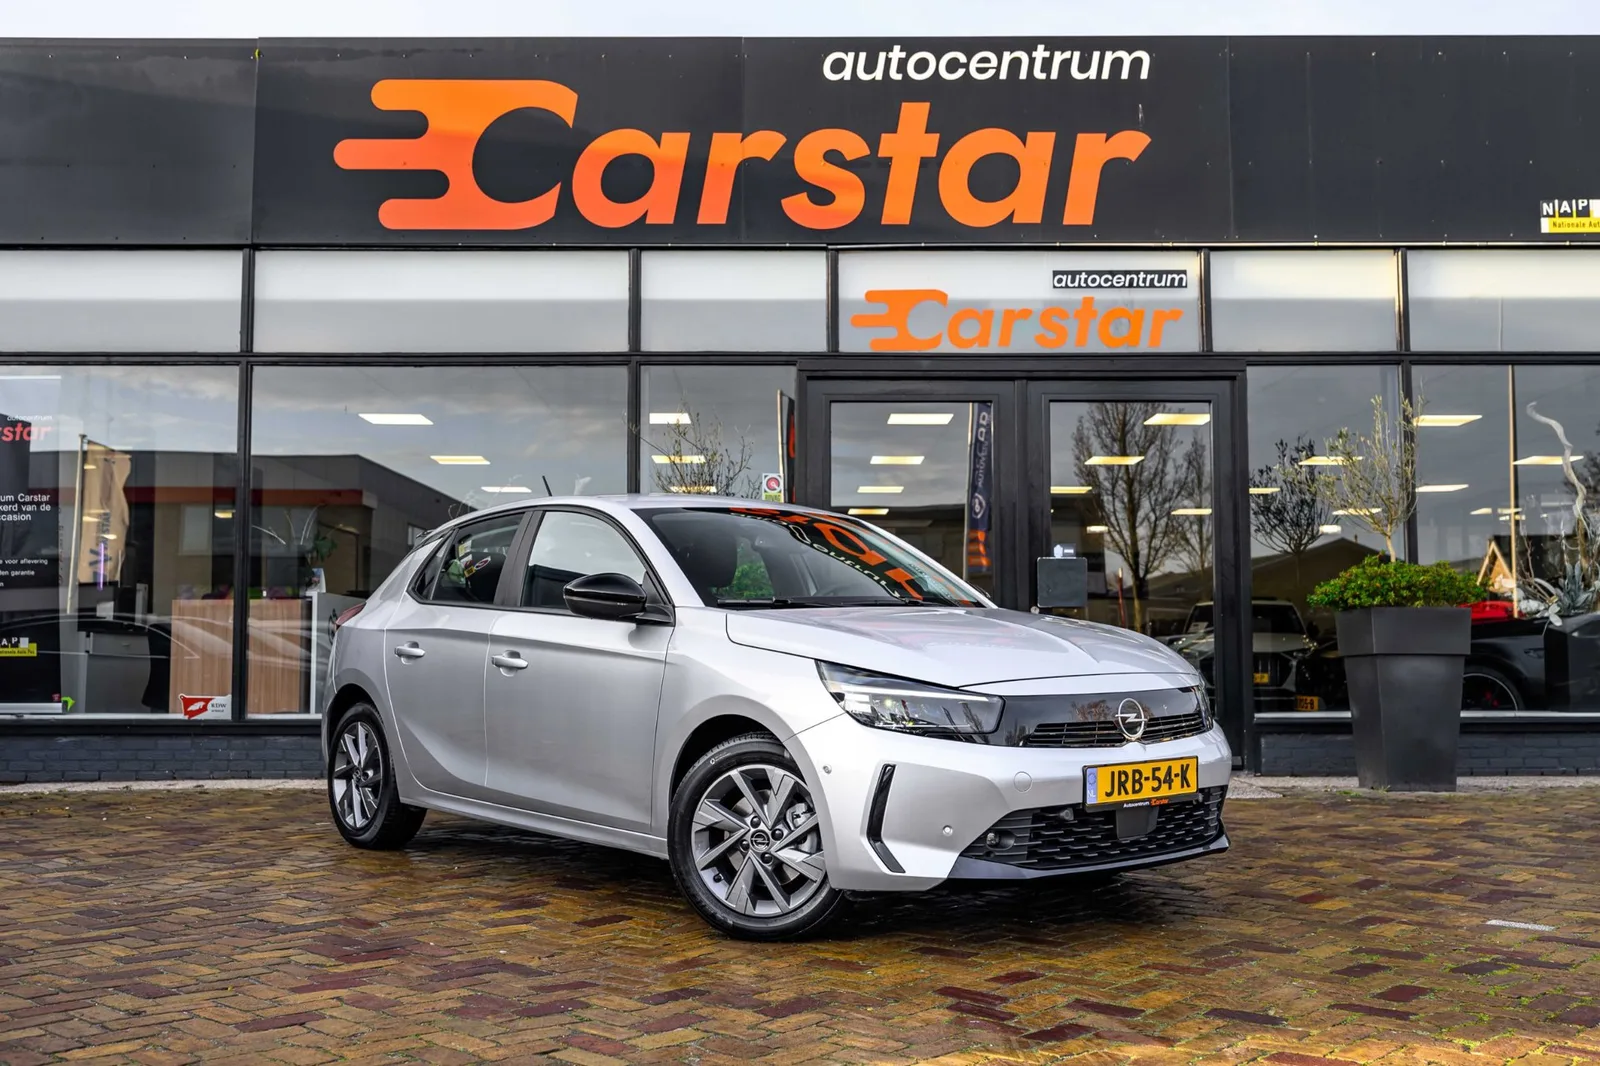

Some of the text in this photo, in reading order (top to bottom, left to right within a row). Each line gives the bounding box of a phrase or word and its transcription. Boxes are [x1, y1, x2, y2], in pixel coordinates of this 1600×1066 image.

[822, 44, 1151, 81] autocentrum
[333, 79, 1152, 230] Carstar
[1053, 271, 1187, 288] autocentrum
[850, 289, 1184, 351] Carstar
[0, 422, 52, 442] star
[17, 493, 51, 502] Carstar
[40, 503, 51, 511] de
[0, 513, 31, 521] casion
[1105, 763, 1191, 797] JRB-54-K
